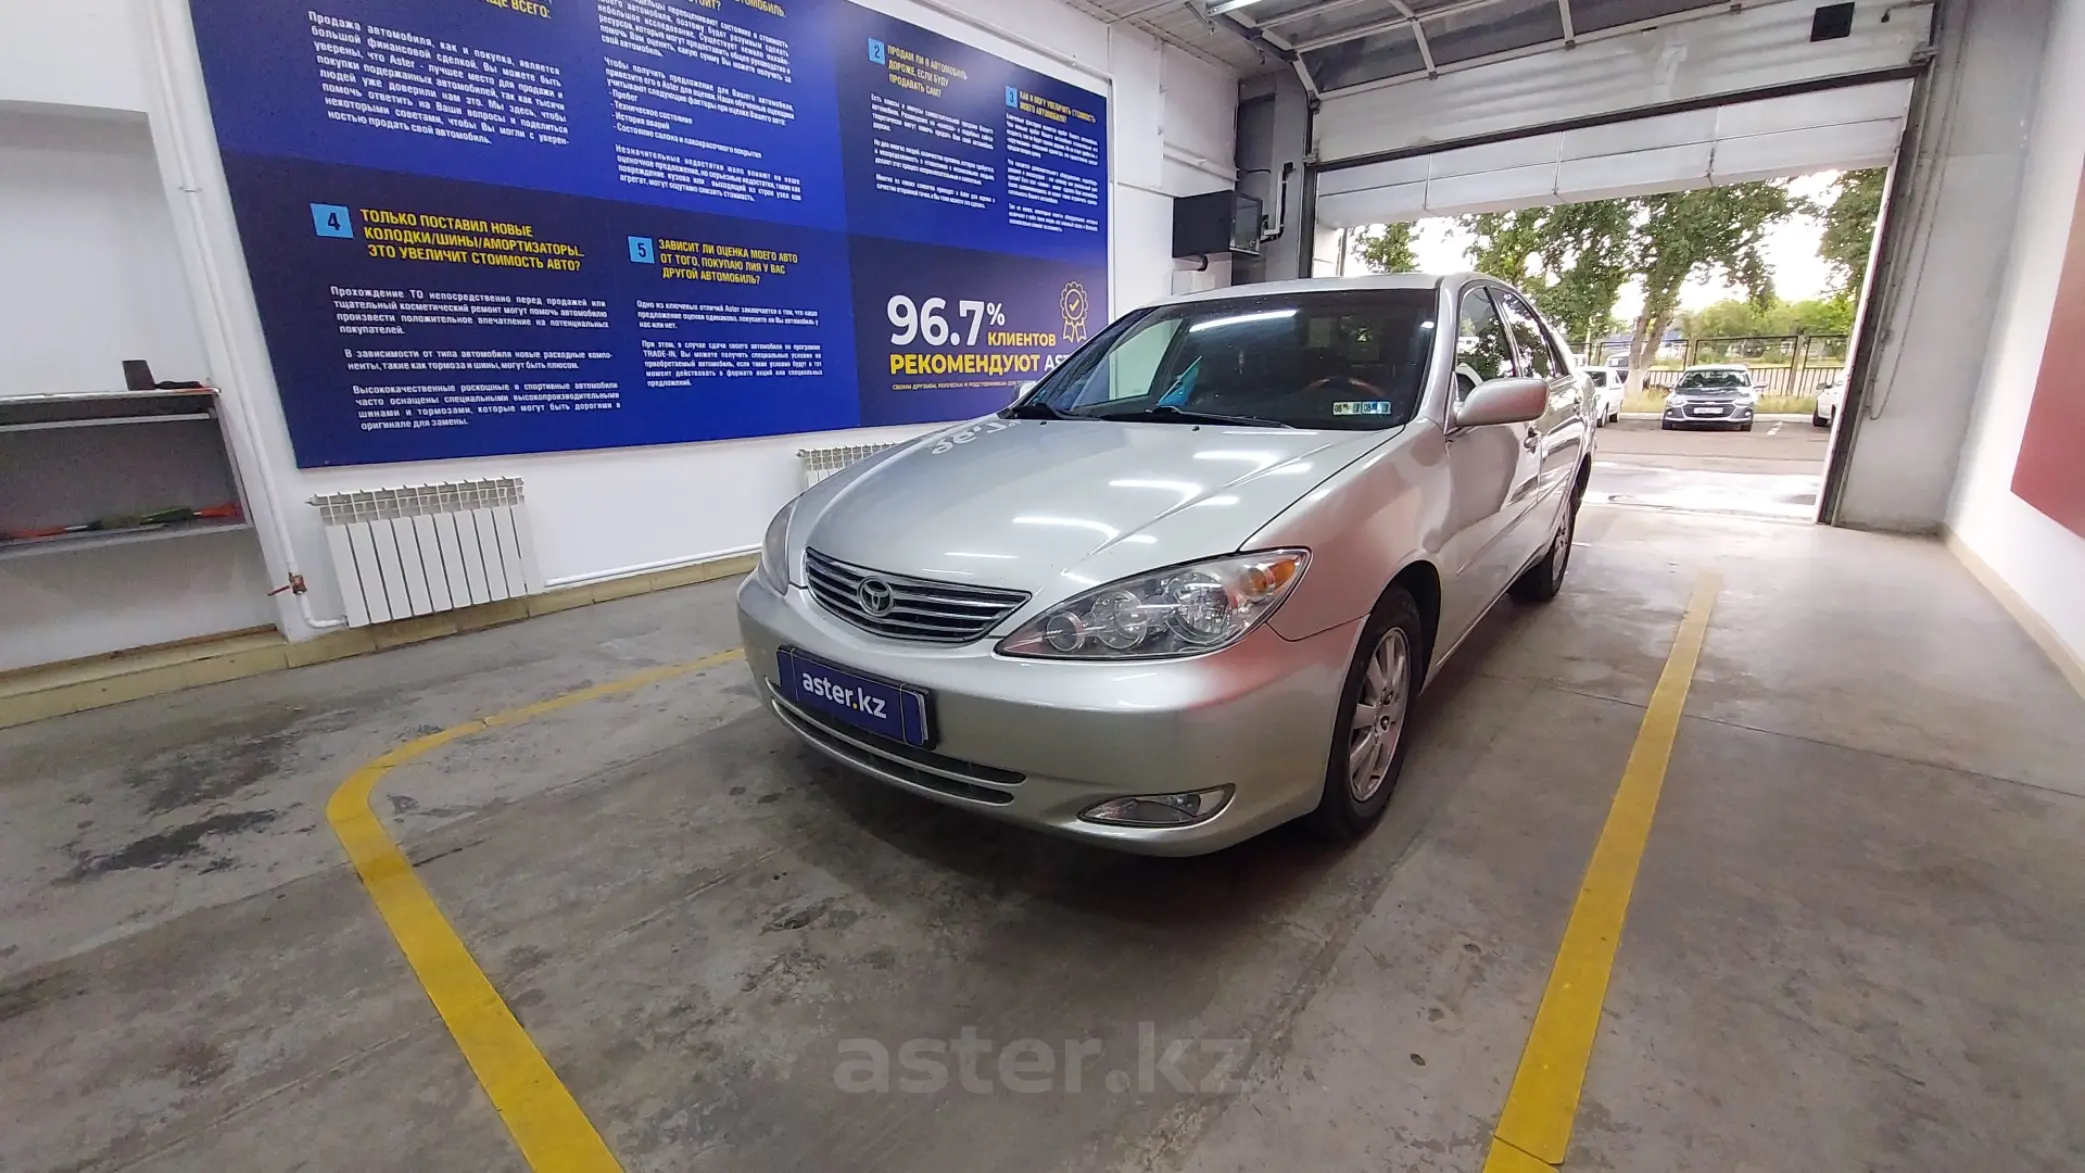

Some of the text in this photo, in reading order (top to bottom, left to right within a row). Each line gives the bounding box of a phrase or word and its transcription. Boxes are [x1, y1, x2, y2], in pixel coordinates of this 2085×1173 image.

[308, 10, 360, 30] Продажа
[367, 25, 434, 47] автомобиля,
[439, 41, 457, 52] как
[474, 49, 514, 66] покупка,
[519, 59, 559, 74] является
[874, 45, 880, 58] 2
[311, 25, 561, 86] большой финансовой сделкой. Вы можете быть
[313, 41, 363, 58] уверены,
[367, 51, 384, 62] что
[428, 64, 463, 78] лучшее
[467, 72, 494, 84] место
[498, 78, 514, 88] для
[518, 83, 554, 96] продажи
[316, 55, 564, 110] покупки подержанных автомобилей, так как тысячи
[319, 69, 566, 121] людей уже доверили нам это. Мы здесь, чтобы
[322, 83, 362, 96] помочь
[368, 91, 413, 105] ответить
[418, 100, 430, 109] на
[435, 101, 462, 114] Ваши
[466, 109, 505, 122] вопросы
[520, 119, 567, 133] поделиться
[324, 96, 389, 114] некоторыми
[394, 108, 443, 124] советами,
[447, 118, 476, 129] чтобы
[480, 122, 494, 132] Вы
[499, 126, 525, 137] могли
[538, 134, 568, 144] уверен-
[327, 110, 491, 143] ностью продать свой автомобиль.
[327, 213, 340, 230] 4
[360, 208, 533, 238] ТОЛЬКО ПОСТАВИЛ НОВЫЕ
[368, 244, 580, 272] ЭТО УВЕЛИЧИТ СТОИМОСТЬ АВТО?
[637, 243, 646, 257] 5
[658, 238, 798, 264] ЗАВИСИТ ЛИ ОЦЕНКА МОЕГО АВТО
[660, 254, 672, 265] ОТ
[702, 257, 743, 270] ПОКУПАЮ
[764, 263, 770, 273] У
[771, 264, 786, 275] ВАС
[662, 267, 760, 285] ДРУГОЙ АВТОМОБИЛЬ?
[330, 286, 403, 298] Прохождение
[409, 289, 423, 298] ТО
[429, 292, 510, 302] непосредственно
[516, 296, 542, 304] перед
[333, 300, 397, 309] тщательный
[399, 303, 468, 311] косметический
[470, 305, 500, 313] ремонт
[503, 307, 526, 315] могут
[336, 313, 395, 321] произвести
[400, 314, 472, 323] положительное
[477, 317, 531, 325] впечатление
[339, 325, 404, 334] покупателей.
[988, 332, 1056, 347] КЛИЕНТОВ
[344, 348, 352, 357] В
[427, 362, 466, 370] тормоза
[890, 354, 1040, 375] РЕКОМЕНДУЮТ
[352, 385, 455, 393] Высококачественные
[460, 384, 509, 392] роскошные
[360, 420, 411, 430] оригинале
[413, 420, 430, 428] для
[803, 672, 886, 719] aster.kz
